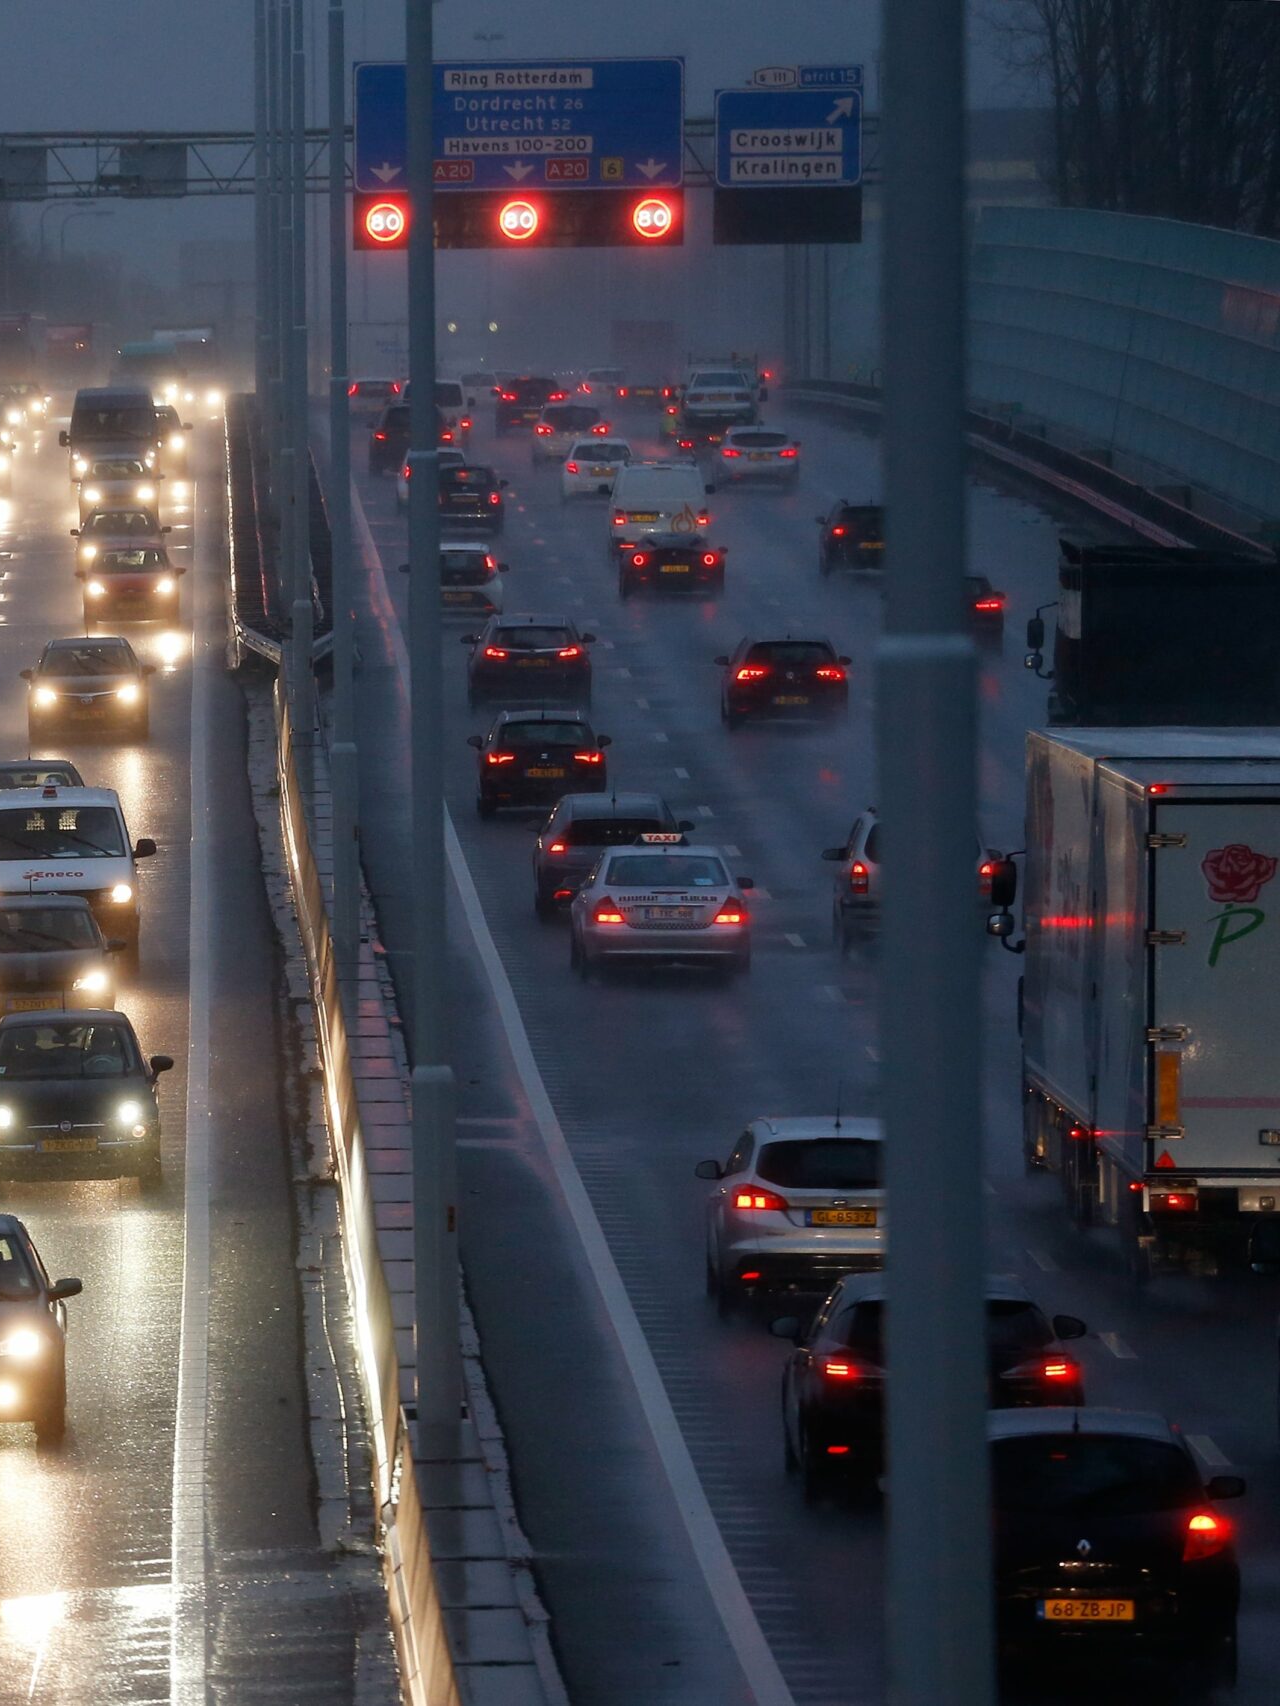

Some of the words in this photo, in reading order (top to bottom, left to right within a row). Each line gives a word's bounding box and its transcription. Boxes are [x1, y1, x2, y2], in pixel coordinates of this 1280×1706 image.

[451, 72, 488, 88] Ring
[495, 70, 583, 86] Rotterdam
[840, 70, 856, 82] 15
[454, 96, 557, 112] Dordrecht
[563, 99, 584, 110] 26
[465, 116, 544, 132] Utrecht
[551, 119, 571, 131] 52
[449, 140, 510, 153] Havens
[515, 138, 587, 152] 100-200
[736, 131, 836, 150] Crooswijk
[434, 165, 471, 179] A20
[549, 163, 584, 177] A20
[606, 163, 618, 176] 6
[736, 160, 837, 178] Kralingen
[370, 213, 399, 230] 80
[503, 211, 534, 229] 80
[637, 209, 668, 228] 80
[646, 834, 677, 842] TAXI
[816, 1209, 872, 1223] GL-853-Z
[1052, 1602, 1126, 1617] 68-ZB-JP
